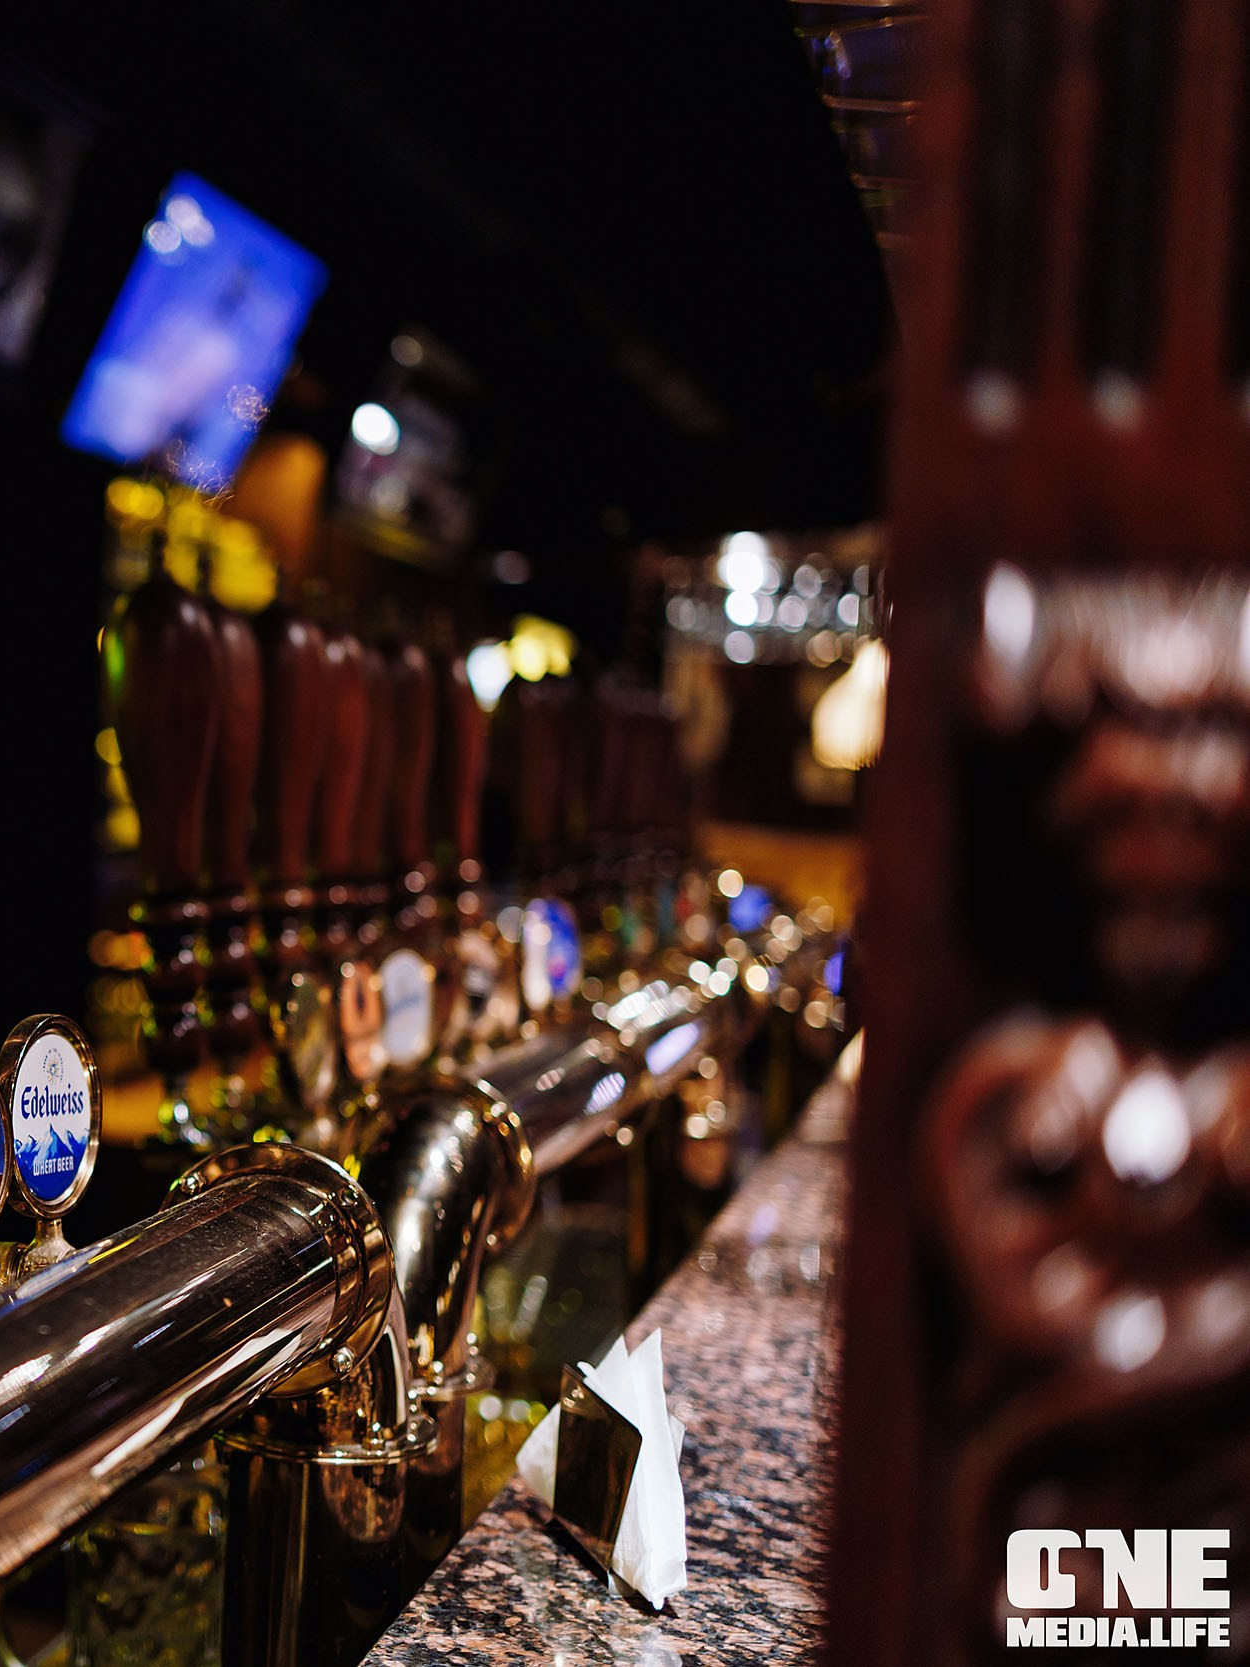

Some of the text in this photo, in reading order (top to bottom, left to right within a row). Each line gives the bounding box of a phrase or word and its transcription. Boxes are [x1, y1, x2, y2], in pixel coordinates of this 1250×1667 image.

[21, 1083, 84, 1120] Edelweiss
[33, 1156, 75, 1177] WHEAT BEER
